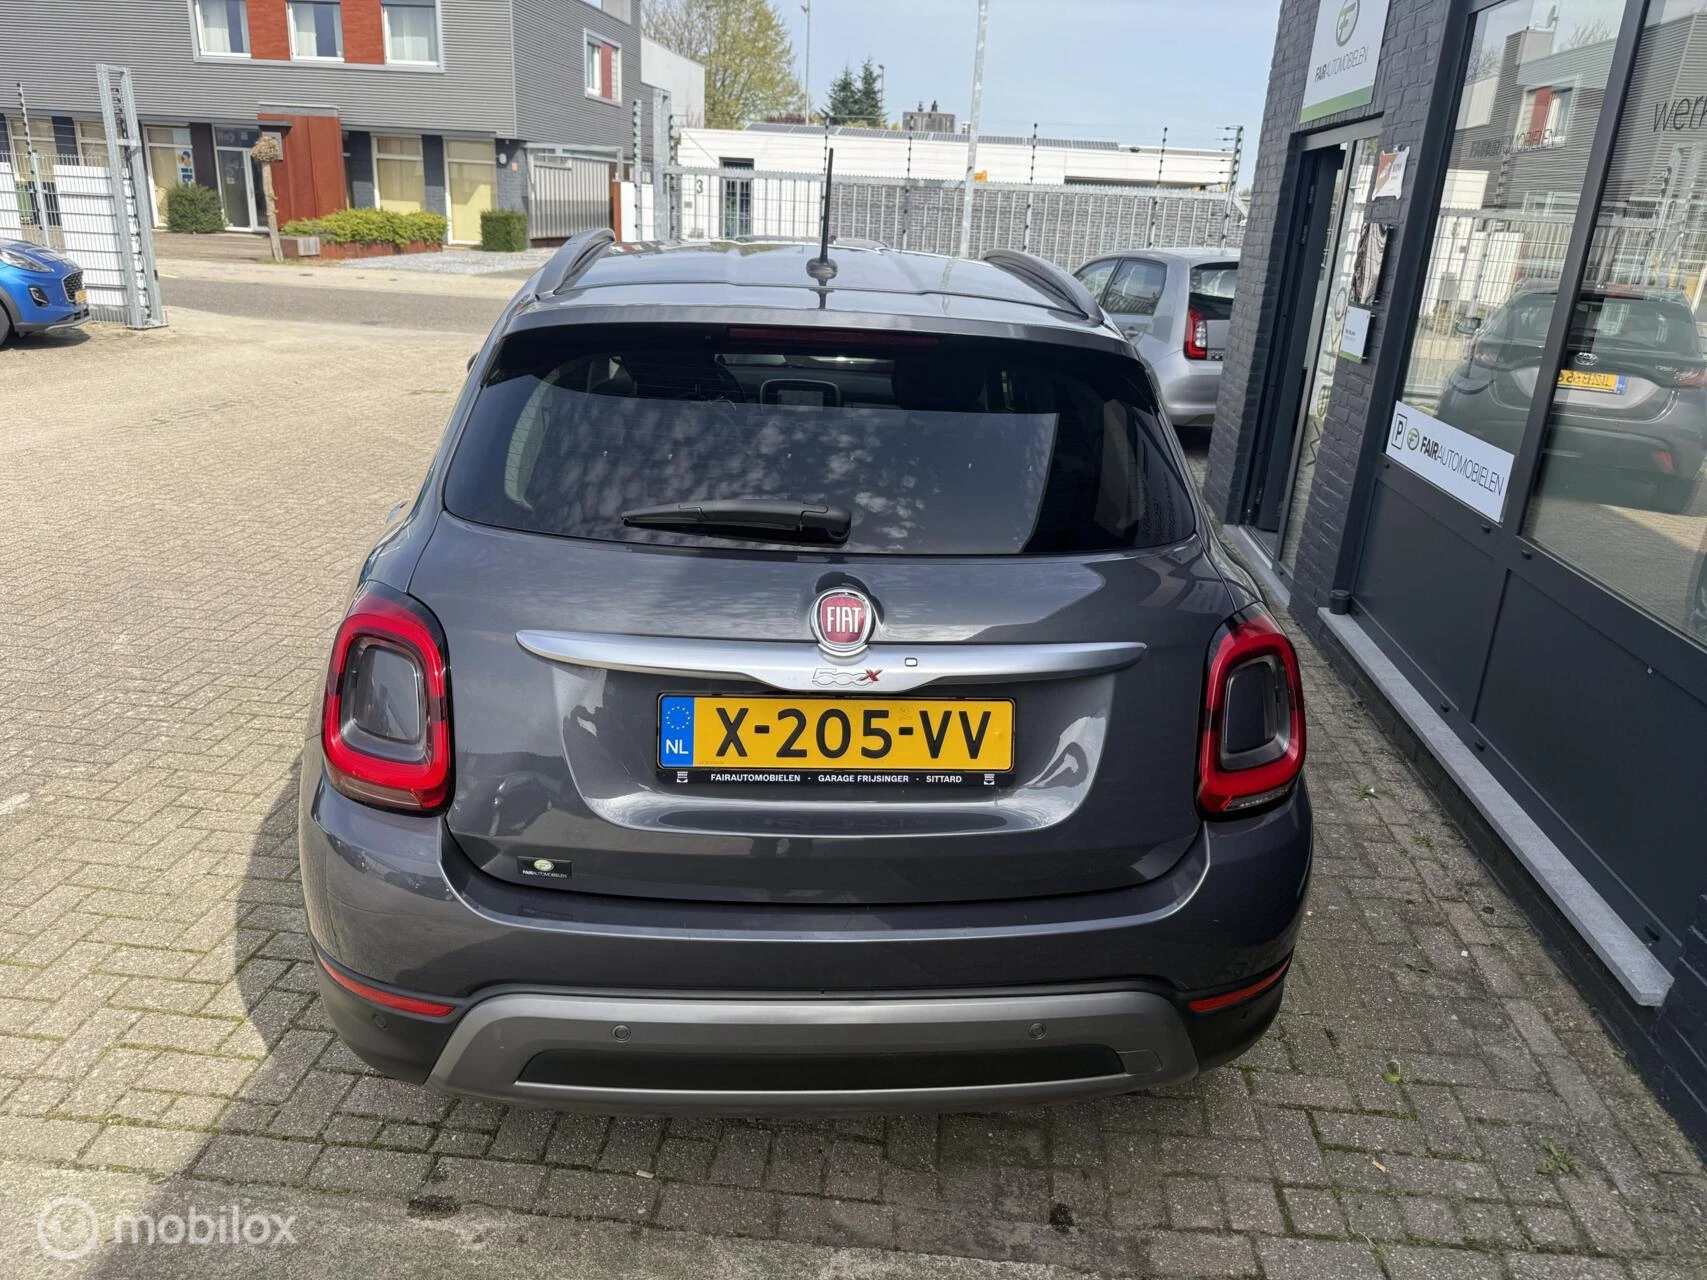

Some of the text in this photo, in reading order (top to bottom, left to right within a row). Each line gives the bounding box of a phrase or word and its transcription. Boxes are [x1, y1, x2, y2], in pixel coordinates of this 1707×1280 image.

[696, 179, 703, 194] 3
[1395, 420, 1504, 496] P FAIRAUTOMOBIELEN
[826, 605, 862, 634] FIAT
[715, 707, 992, 760] X-205-VV
[665, 738, 689, 755] NL
[710, 773, 963, 784] FAIRAUTOMOBIELEN GARAGE FRIJSINGER SITTARD
